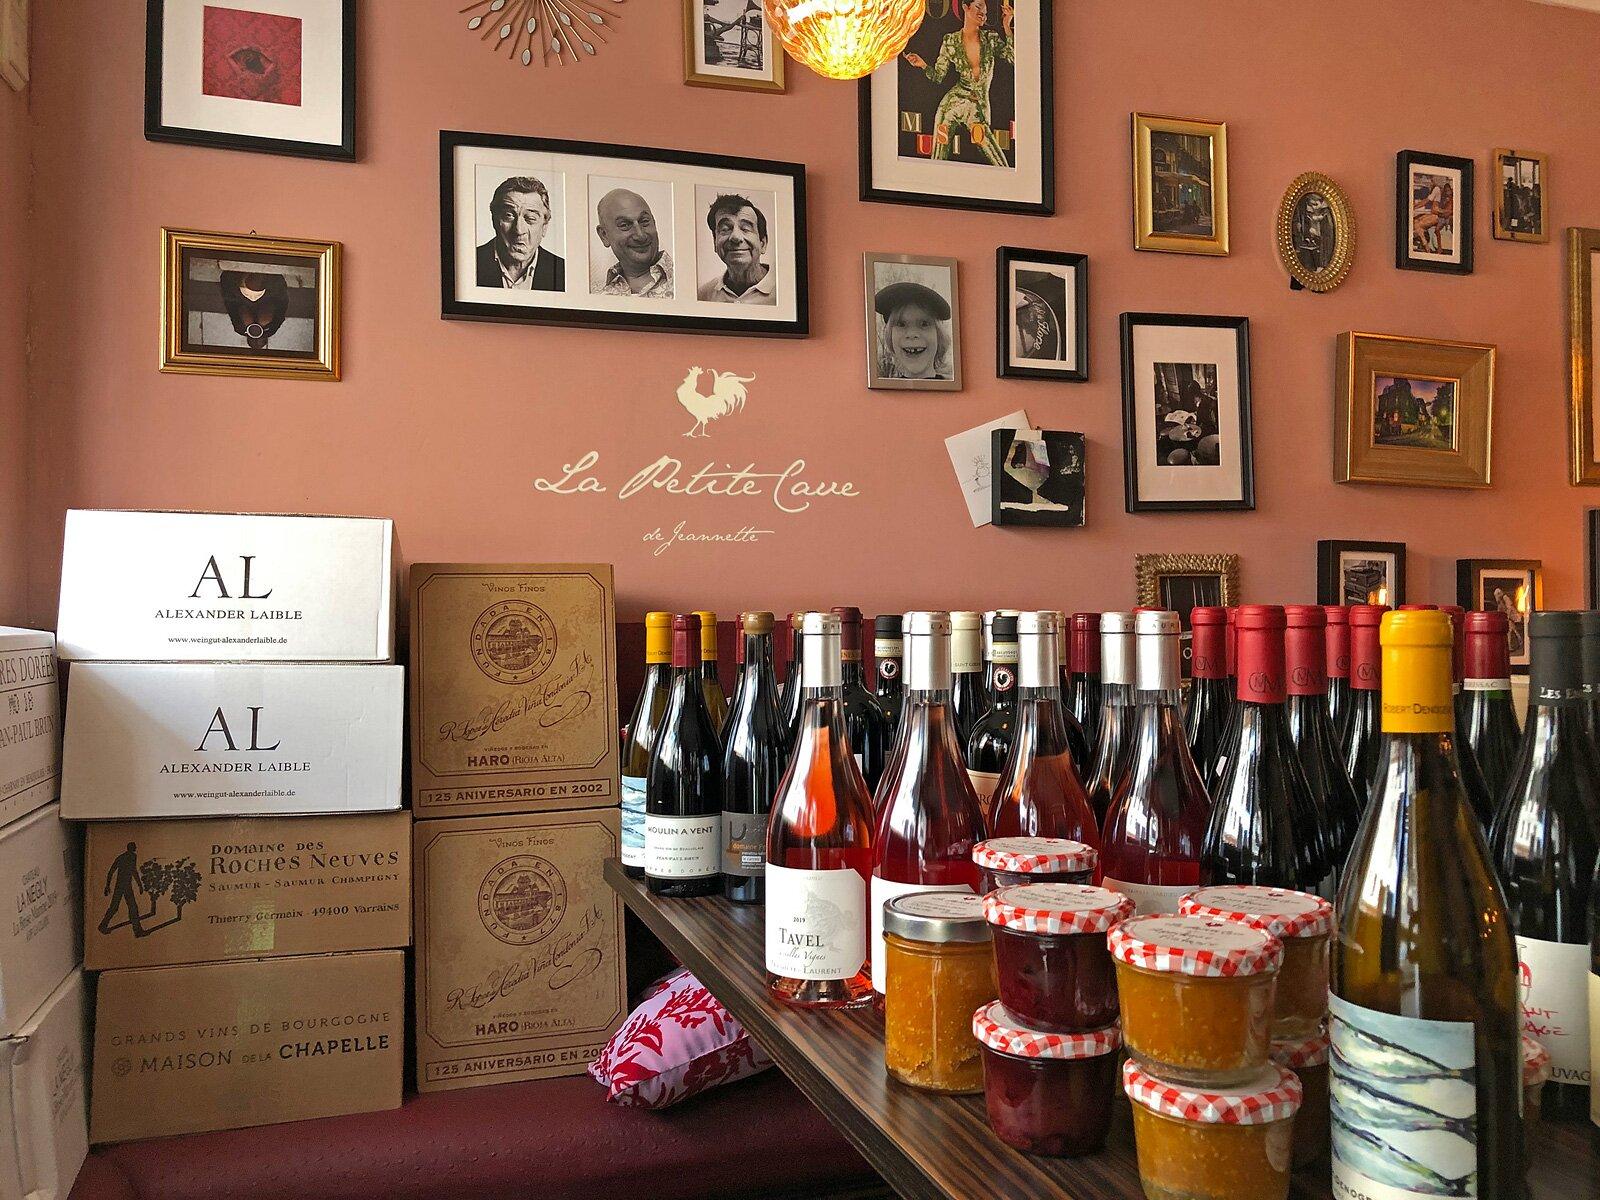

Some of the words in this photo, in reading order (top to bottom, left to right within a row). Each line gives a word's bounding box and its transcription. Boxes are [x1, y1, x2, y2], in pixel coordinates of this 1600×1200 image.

[534, 450, 607, 495] La
[619, 455, 788, 500] Petite
[773, 459, 860, 513] Cave
[643, 526, 665, 542] de
[654, 520, 775, 556] Jeannette
[188, 554, 273, 600] AL
[154, 608, 246, 620] ALEXANDER
[250, 609, 303, 621] LAIBLE
[168, 635, 288, 646] www.weingut-alexanderlaible.de
[194, 706, 281, 752] AL
[159, 762, 253, 773] ALEXANDER
[258, 762, 311, 773] LAIBLE
[467, 754, 510, 767] HARO
[173, 789, 296, 800] www.weingut-alexanderlaible.de
[427, 793, 451, 802] 125
[456, 787, 545, 801] ANIVERSARIO
[550, 785, 567, 795] EN
[572, 783, 603, 794] 2002
[690, 826, 714, 835] VENT
[311, 905, 349, 917] 49400
[779, 927, 825, 948] TAVEL
[803, 964, 842, 975] LAURENT
[111, 1030, 186, 1047] GRANDS
[197, 1025, 239, 1040] VINS
[249, 1023, 272, 1034] DE
[282, 1012, 391, 1031] BOURGOGNE
[475, 1021, 519, 1036] HARO
[139, 1050, 233, 1073] MAISON
[278, 1034, 390, 1060] CHAPELLE
[434, 1064, 459, 1076] 125
[464, 1053, 555, 1072] ANIVERSARIO
[560, 1051, 578, 1061] EN
[582, 1049, 603, 1058] 20
